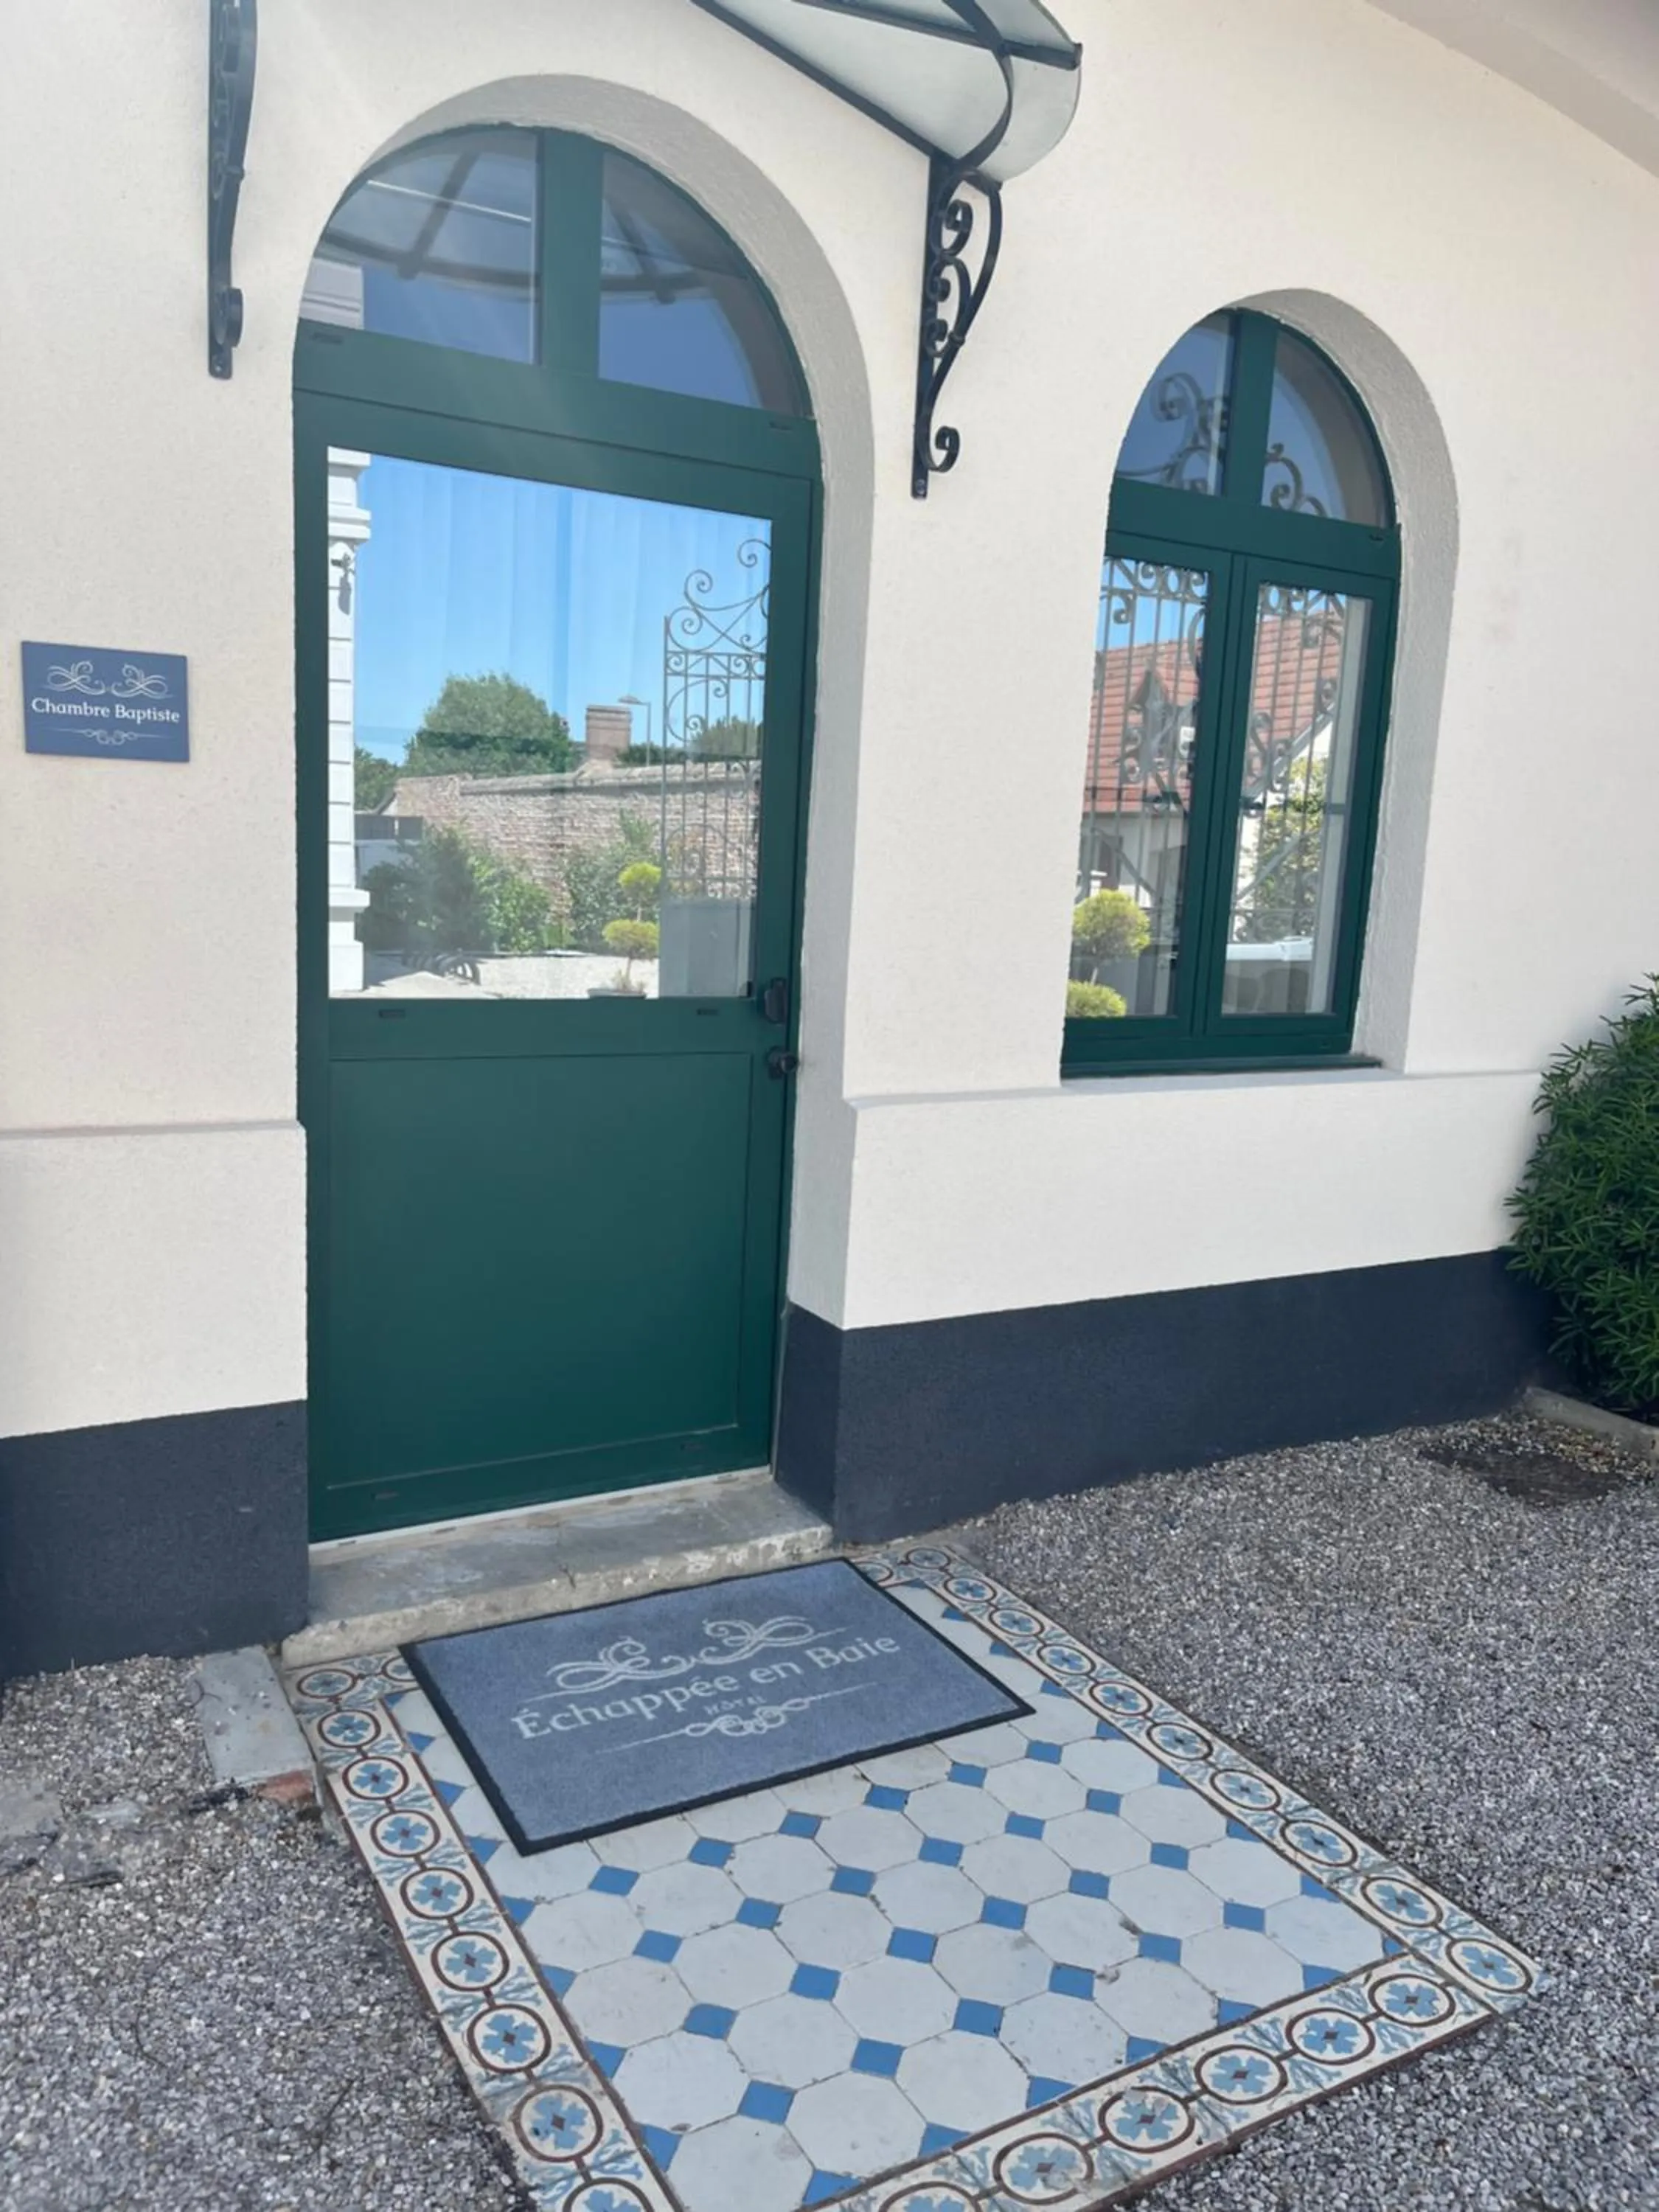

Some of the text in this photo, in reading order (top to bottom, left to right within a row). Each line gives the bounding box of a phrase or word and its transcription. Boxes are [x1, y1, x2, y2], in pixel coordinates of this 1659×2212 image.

[32, 697, 181, 725] Chambre Baptiste
[511, 1637, 900, 1739] Échappée en Baie
